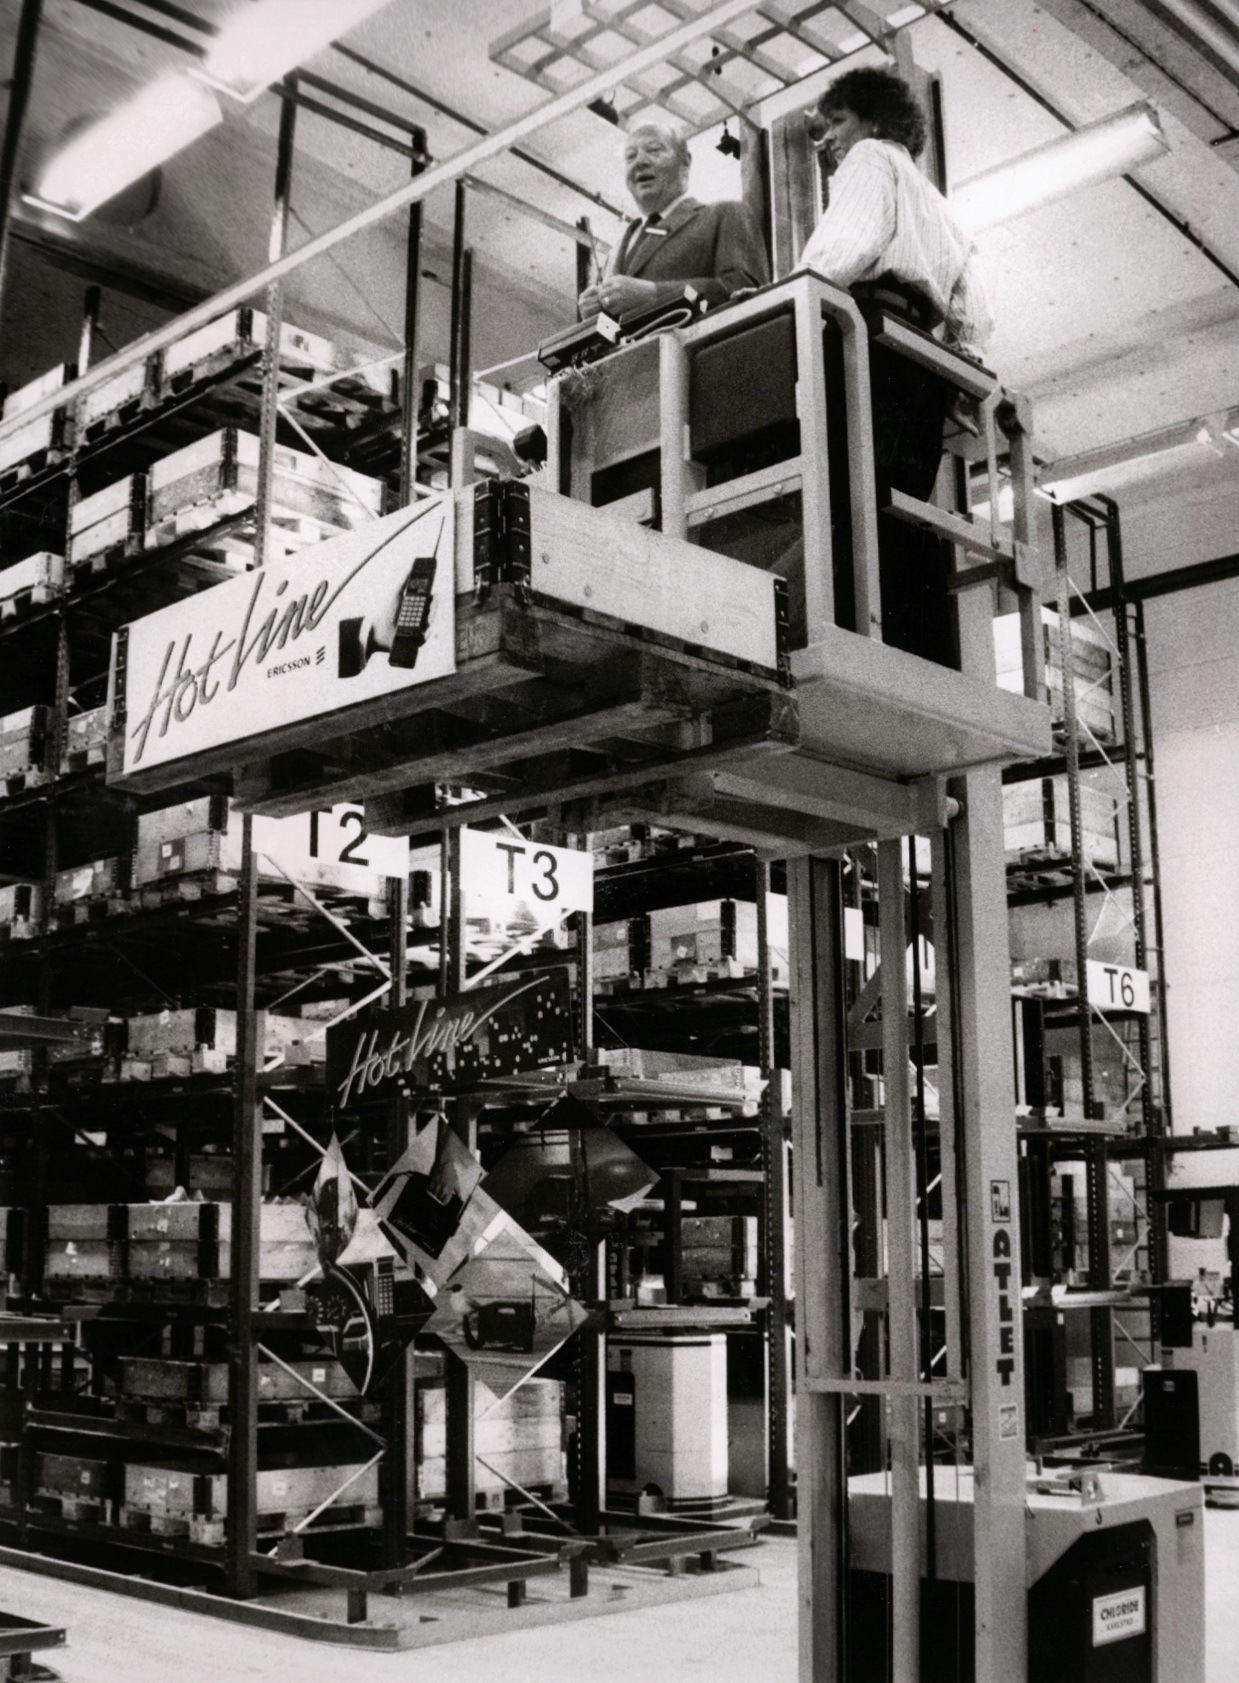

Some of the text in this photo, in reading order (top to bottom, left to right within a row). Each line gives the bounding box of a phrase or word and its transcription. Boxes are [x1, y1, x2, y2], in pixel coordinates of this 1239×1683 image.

[266, 655, 311, 679] ERICSSON
[309, 808, 370, 867] T2
[495, 841, 560, 901] T3
[1103, 967, 1135, 1008] T6
[993, 1228, 1015, 1386] ATLET
[1100, 1599, 1139, 1621] CHLORIDE
